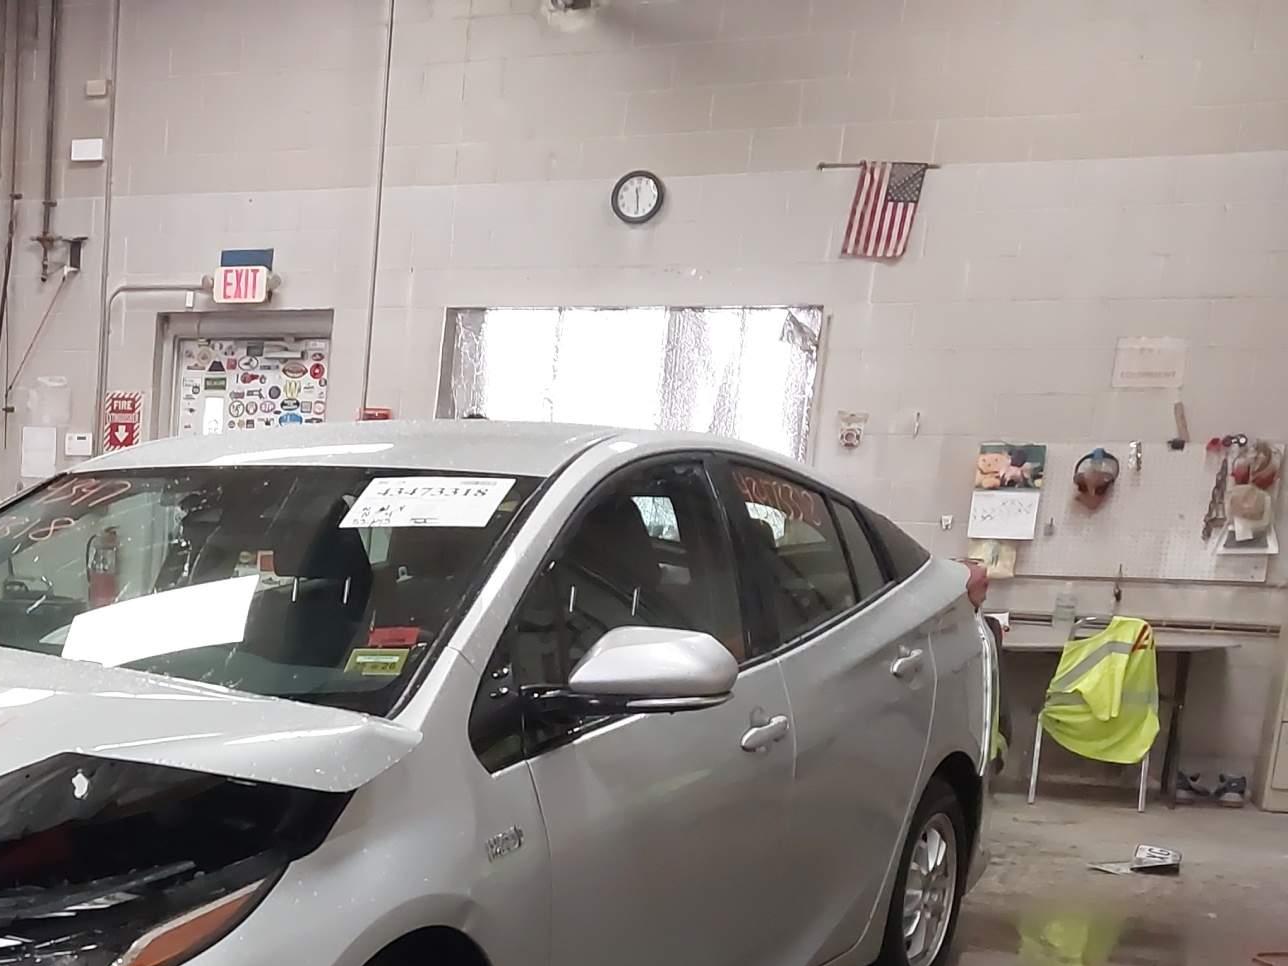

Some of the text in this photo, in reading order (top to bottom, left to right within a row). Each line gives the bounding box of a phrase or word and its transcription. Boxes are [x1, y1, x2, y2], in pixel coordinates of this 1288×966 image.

[223, 269, 260, 299] EXIT
[113, 400, 133, 410] FIRE
[377, 487, 489, 497] 43473318
